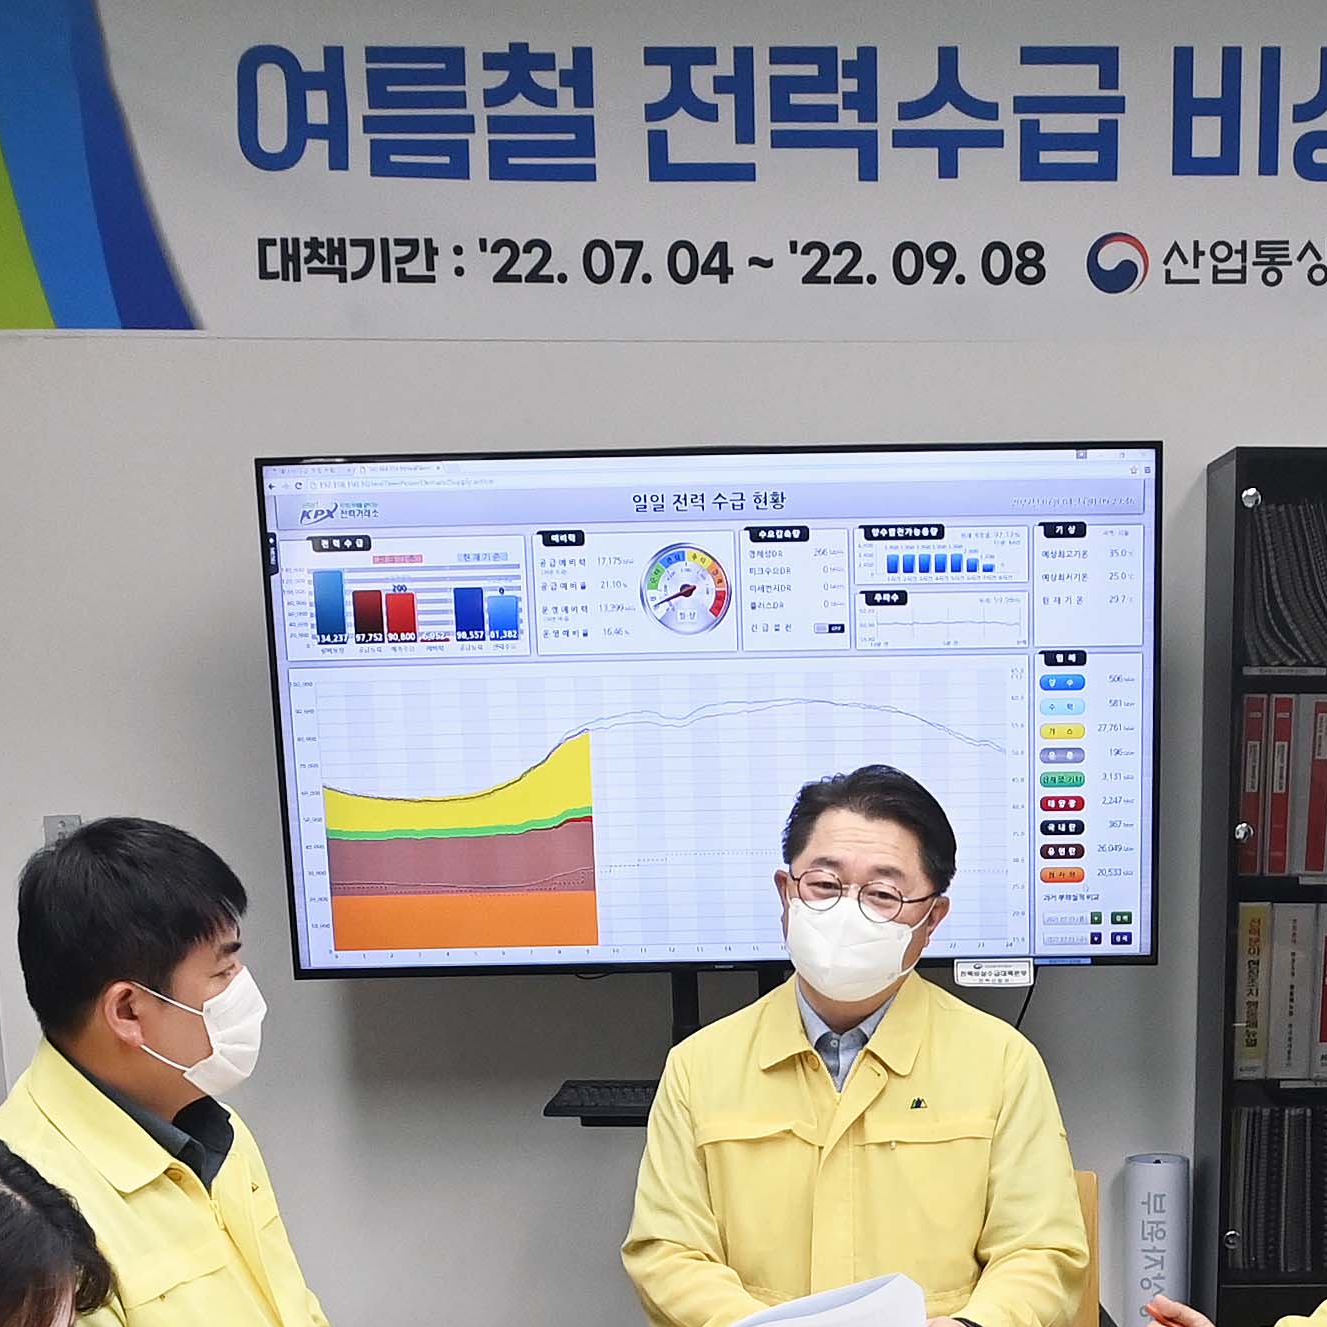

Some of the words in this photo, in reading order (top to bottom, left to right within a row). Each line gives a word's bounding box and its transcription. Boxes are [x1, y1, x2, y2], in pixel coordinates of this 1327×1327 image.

[235, 42, 597, 183] 여름철
[643, 38, 1123, 184] 전력수급
[257, 239, 439, 285] 대책기간
[478, 239, 568, 285] '22.
[583, 240, 652, 285] 07.
[671, 239, 734, 284] 04
[788, 239, 876, 285] '22.
[891, 240, 964, 286] 09.
[980, 242, 1046, 286] 08
[300, 502, 338, 525] KPX
[632, 493, 665, 513] 일일
[673, 492, 705, 512] 전력
[712, 491, 745, 511] 수급
[753, 491, 786, 510] 현황
[356, 632, 384, 643] 97,752
